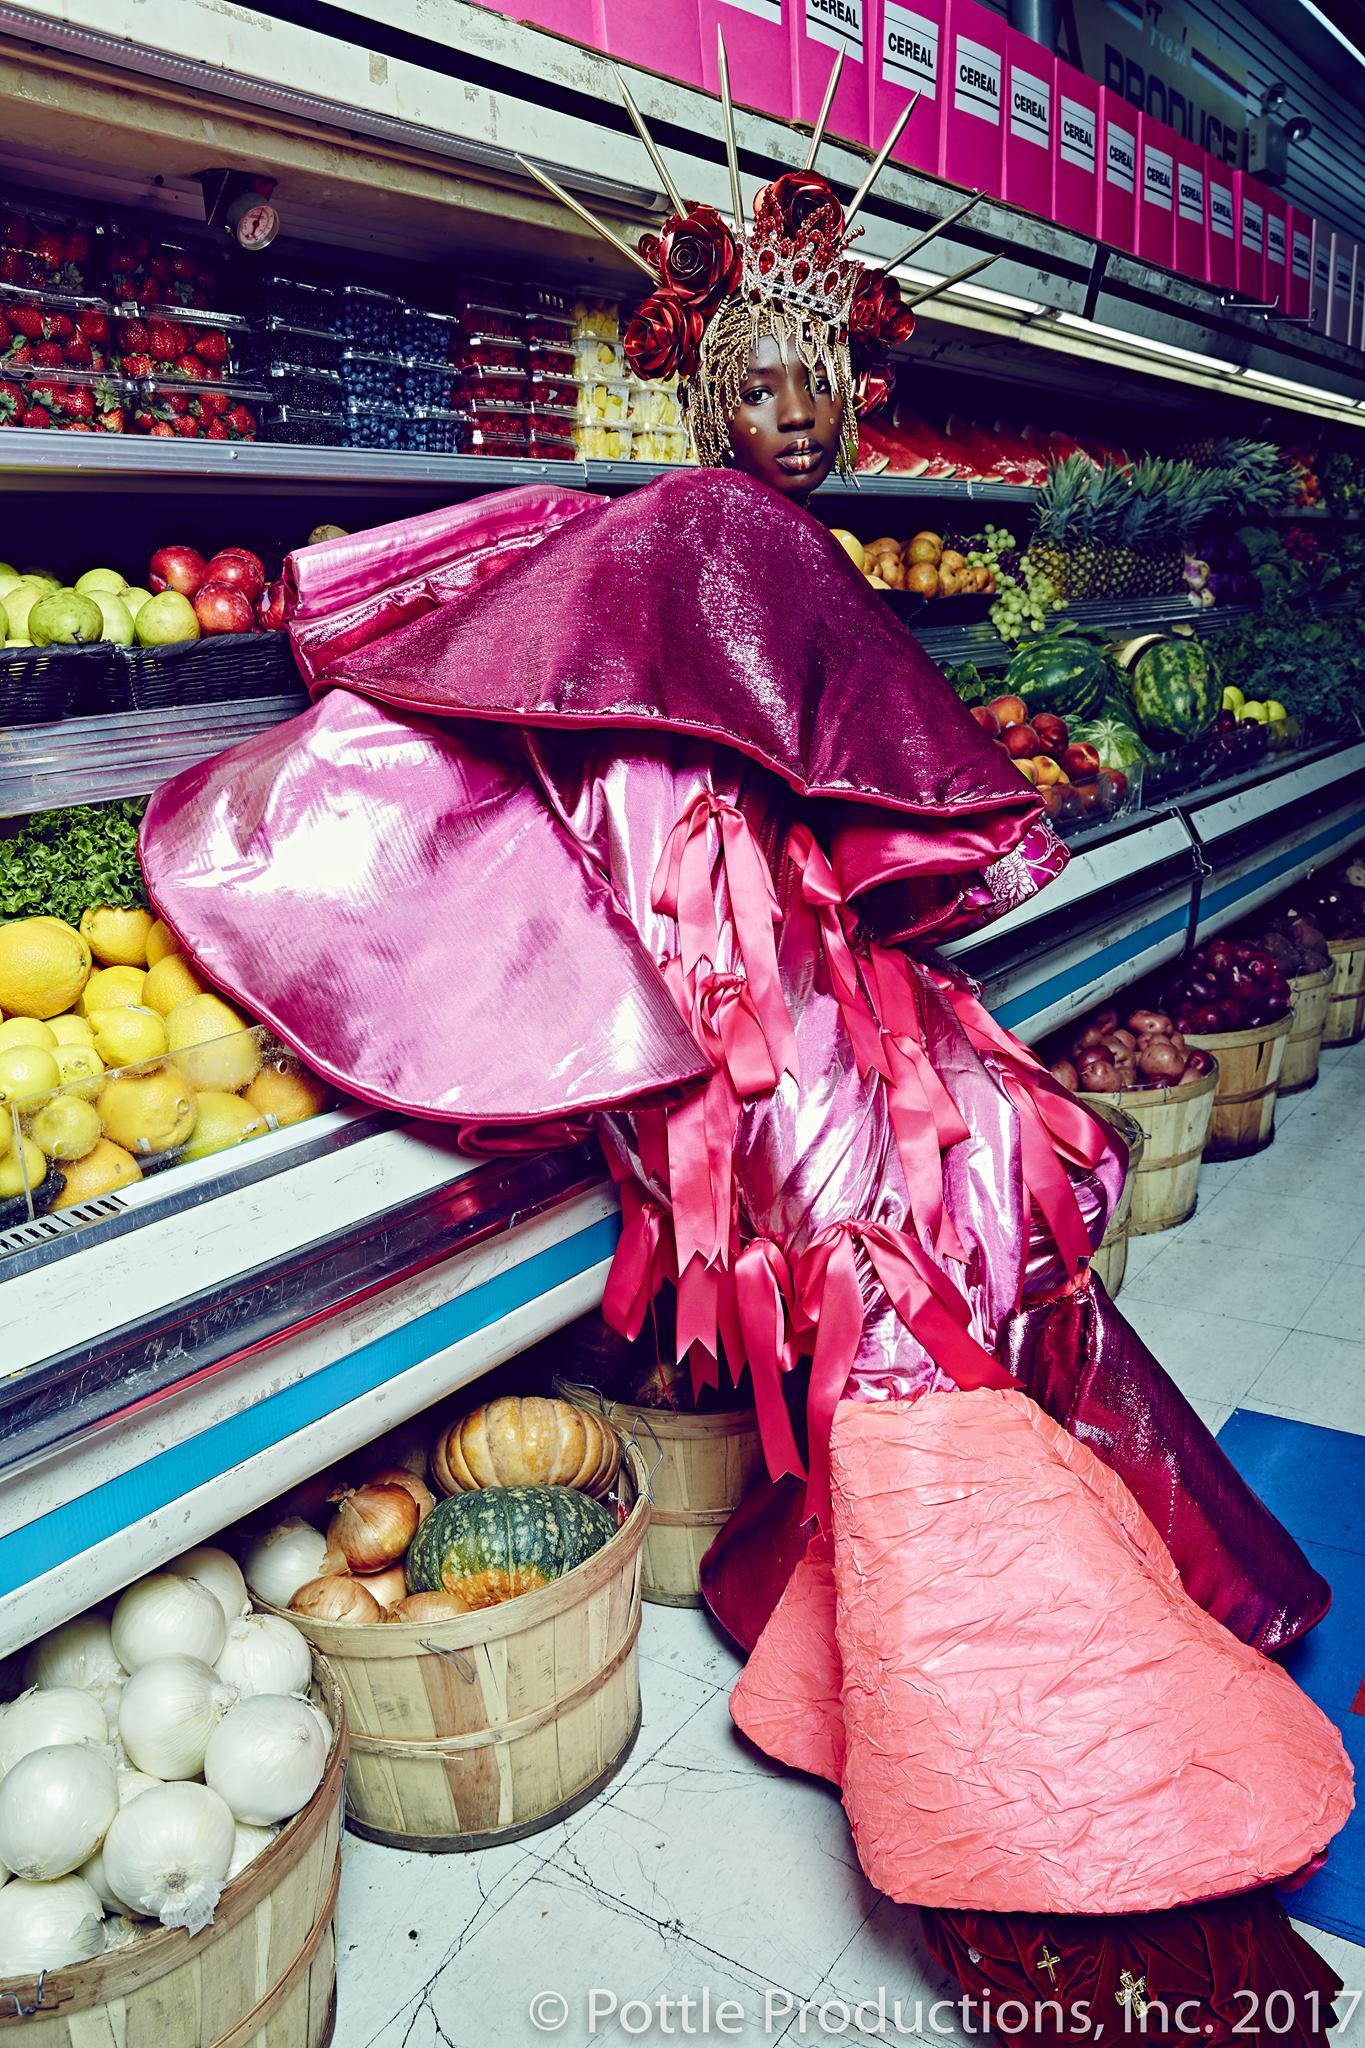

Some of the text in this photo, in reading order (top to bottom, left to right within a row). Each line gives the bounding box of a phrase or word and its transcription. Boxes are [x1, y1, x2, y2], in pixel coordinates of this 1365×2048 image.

[888, 32, 934, 69] CEREAL
[959, 64, 998, 97] CEREAL
[1014, 92, 1048, 123] CEREAL
[1063, 120, 1094, 149] CEREAL
[1109, 145, 1134, 171] CEREAL
[1146, 166, 1172, 189] CEREAL
[1180, 183, 1203, 205] CEREAL
